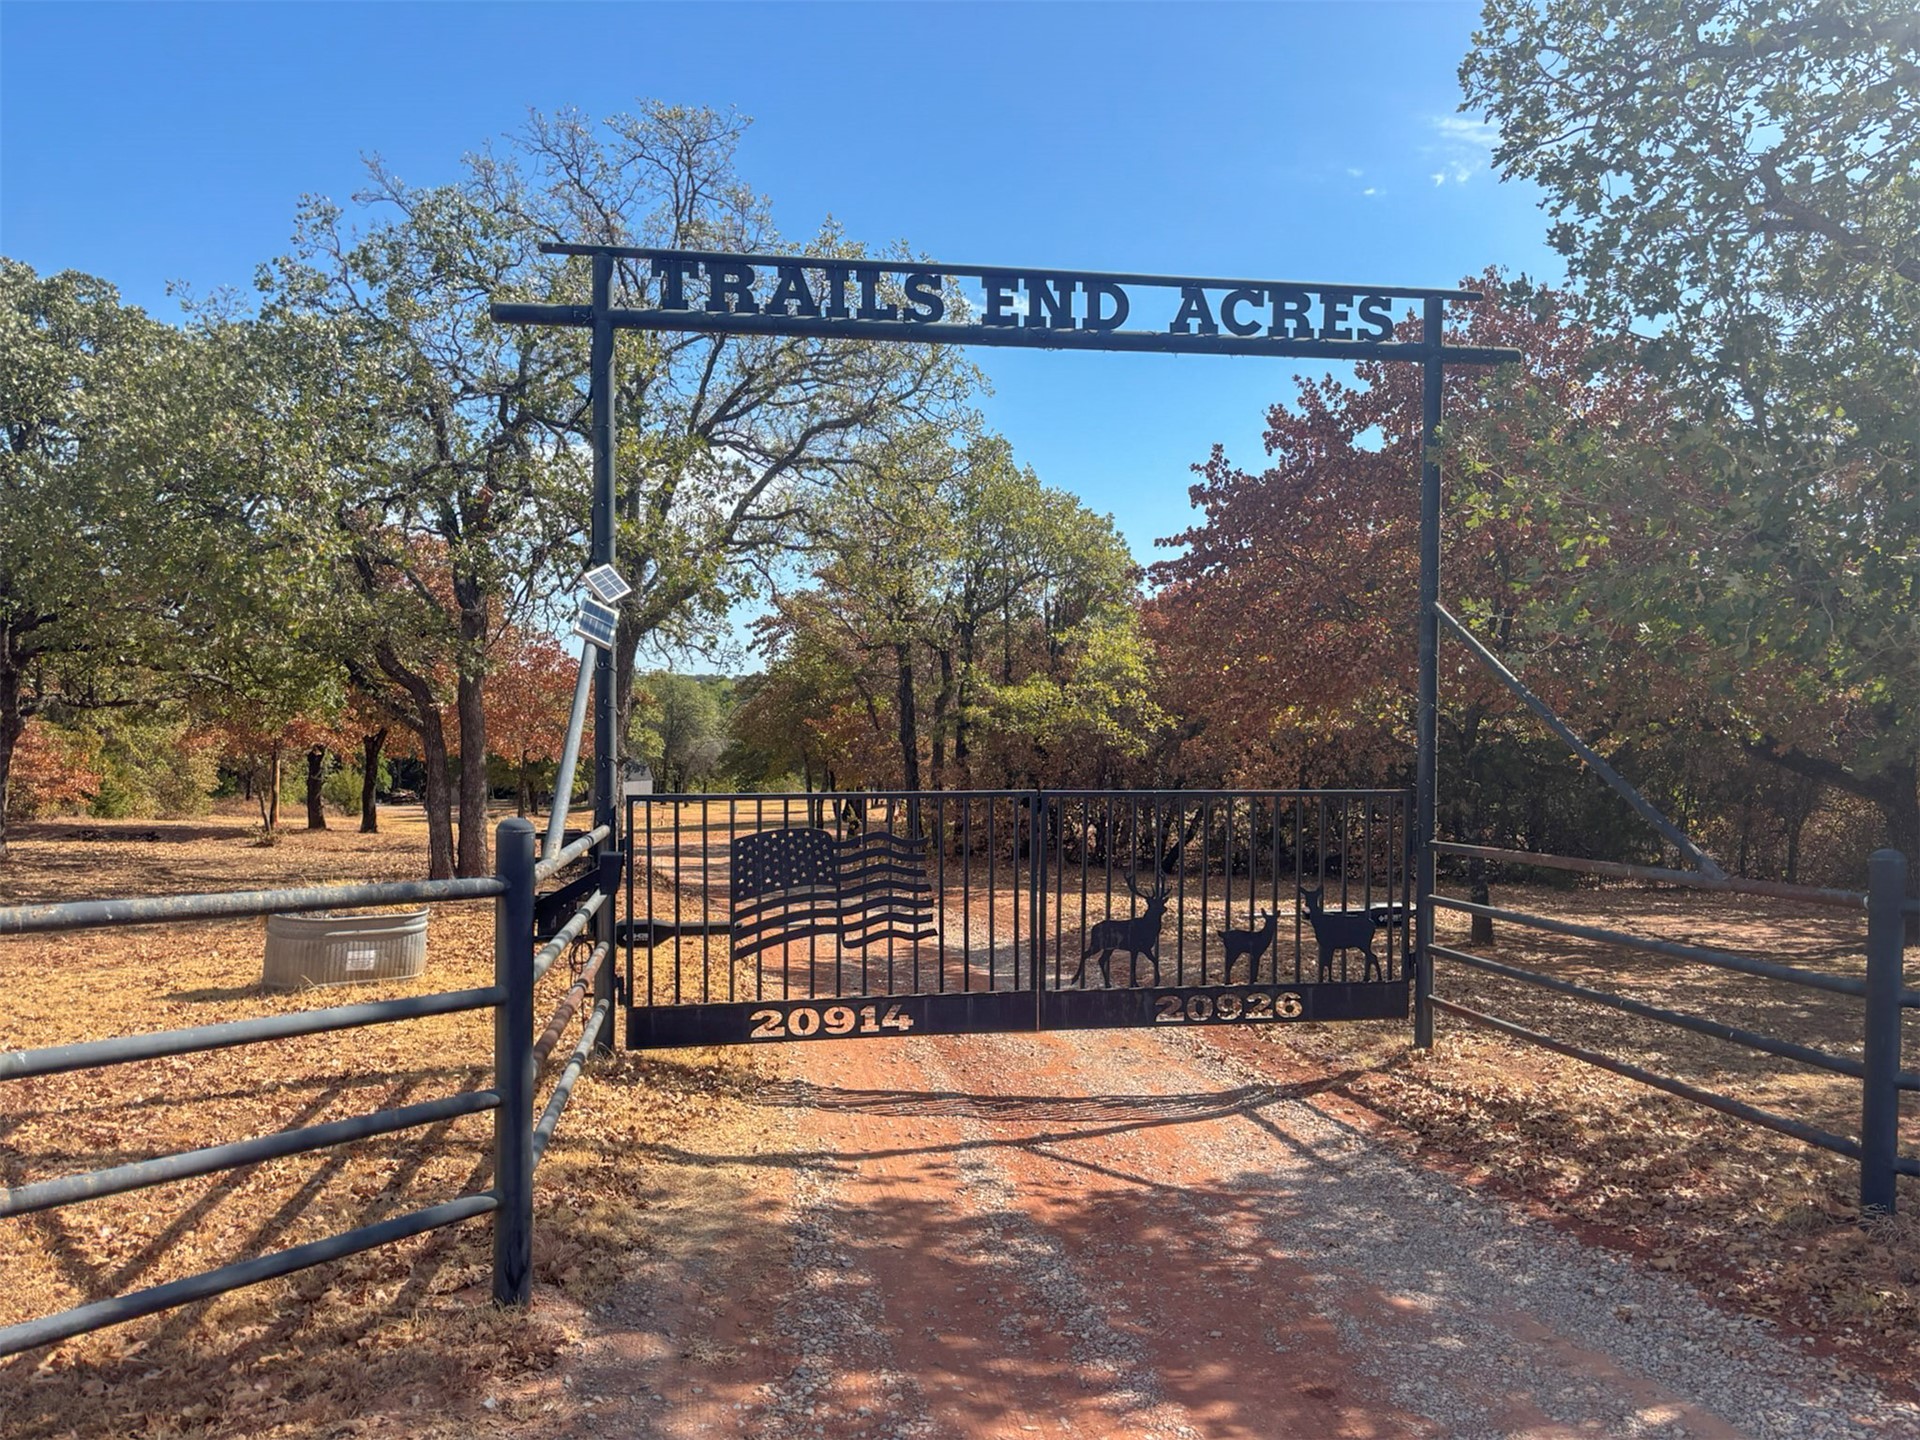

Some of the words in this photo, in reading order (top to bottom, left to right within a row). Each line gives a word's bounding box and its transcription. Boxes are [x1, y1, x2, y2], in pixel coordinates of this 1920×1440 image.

[652, 260, 944, 322] TRAILS
[982, 276, 1130, 330] END
[1169, 286, 1394, 341] ACRES
[750, 1005, 914, 1038] 20914
[1155, 992, 1303, 1022] 20926
